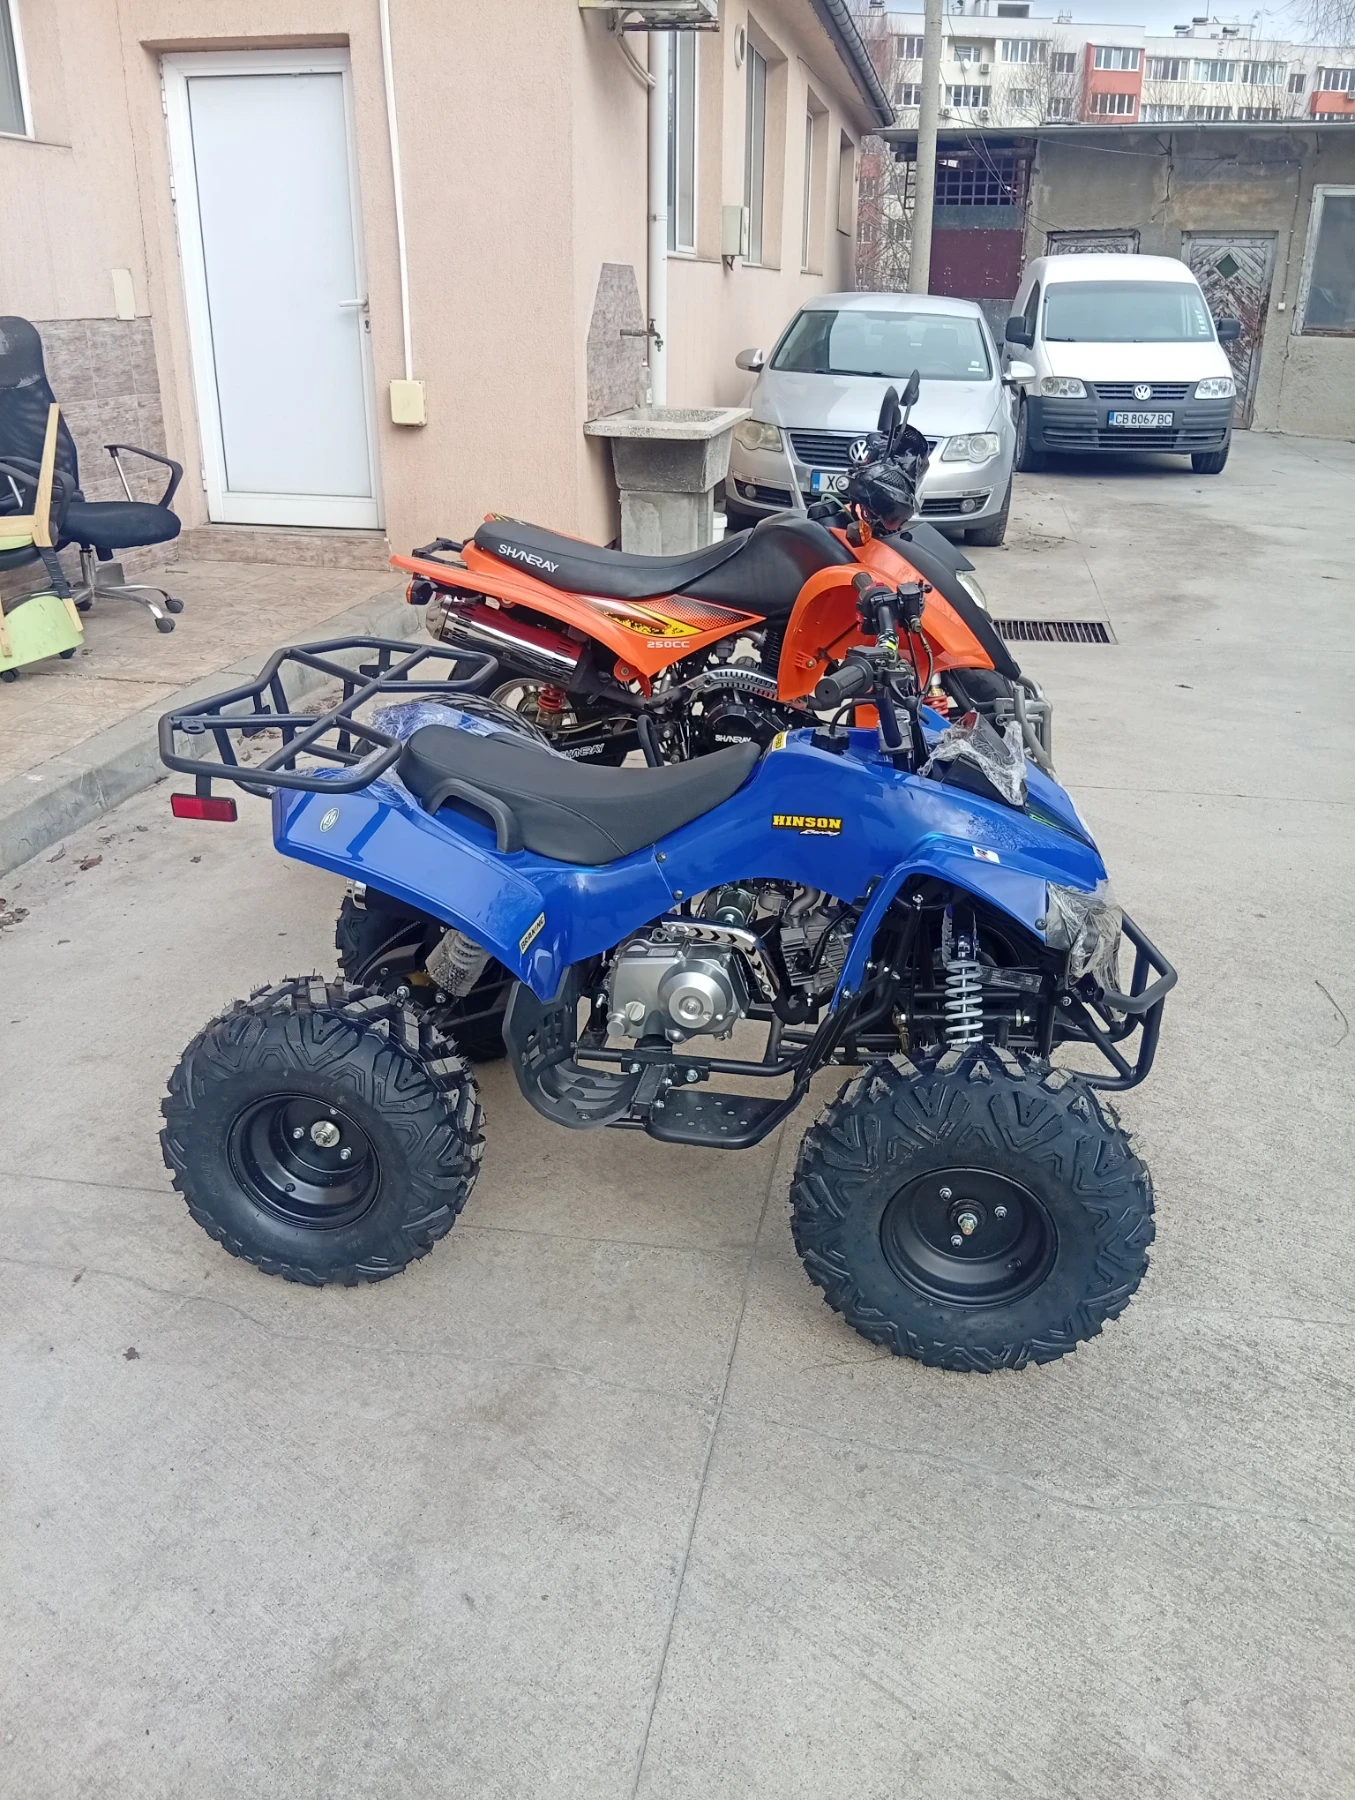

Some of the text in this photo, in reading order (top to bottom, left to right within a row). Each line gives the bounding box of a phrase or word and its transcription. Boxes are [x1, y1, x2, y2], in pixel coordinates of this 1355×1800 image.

[1115, 413, 1172, 425] CB 8067 BC
[646, 640, 690, 649] 250CC
[772, 815, 842, 829] HINSON
